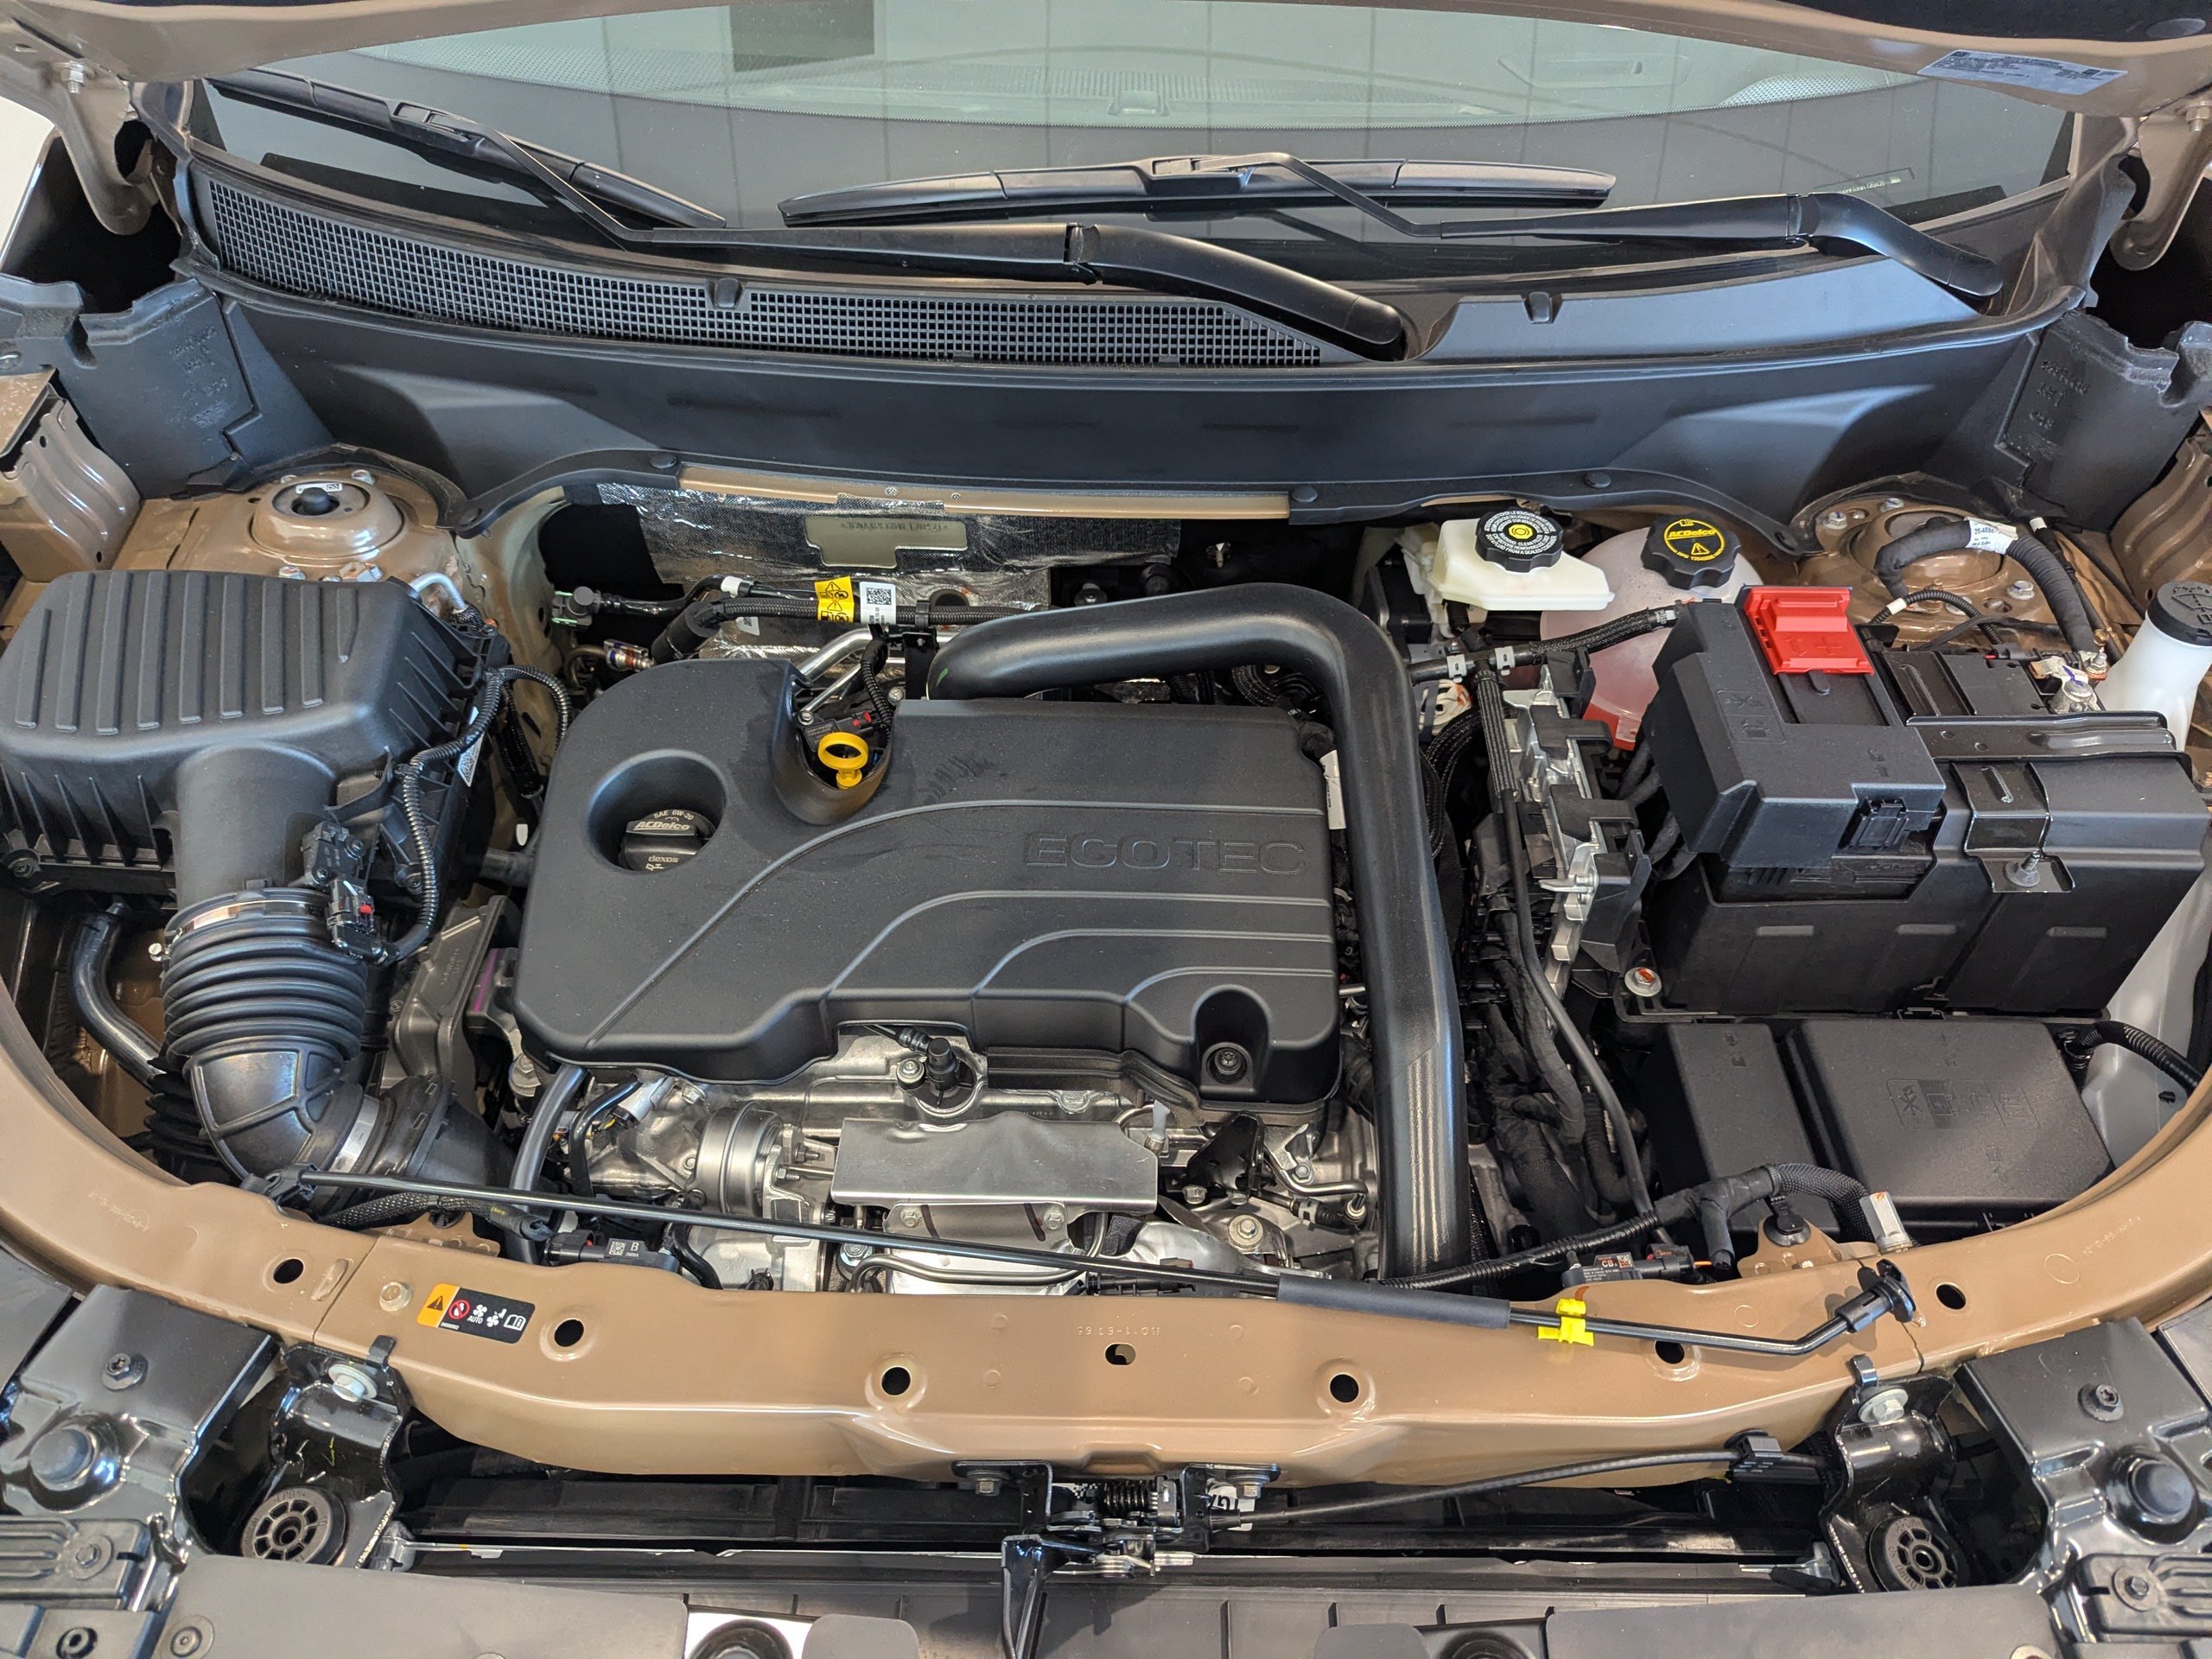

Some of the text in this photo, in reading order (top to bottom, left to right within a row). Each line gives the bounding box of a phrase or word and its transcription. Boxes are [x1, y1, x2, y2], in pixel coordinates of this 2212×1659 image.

[1668, 529, 1717, 538] ACDelco
[653, 810, 695, 821] SAE 0W-20
[632, 821, 690, 830] ACDelco
[1026, 832, 1306, 875] ECOTEC
[630, 1242, 639, 1252] B
[467, 1315, 484, 1325] AUTO
